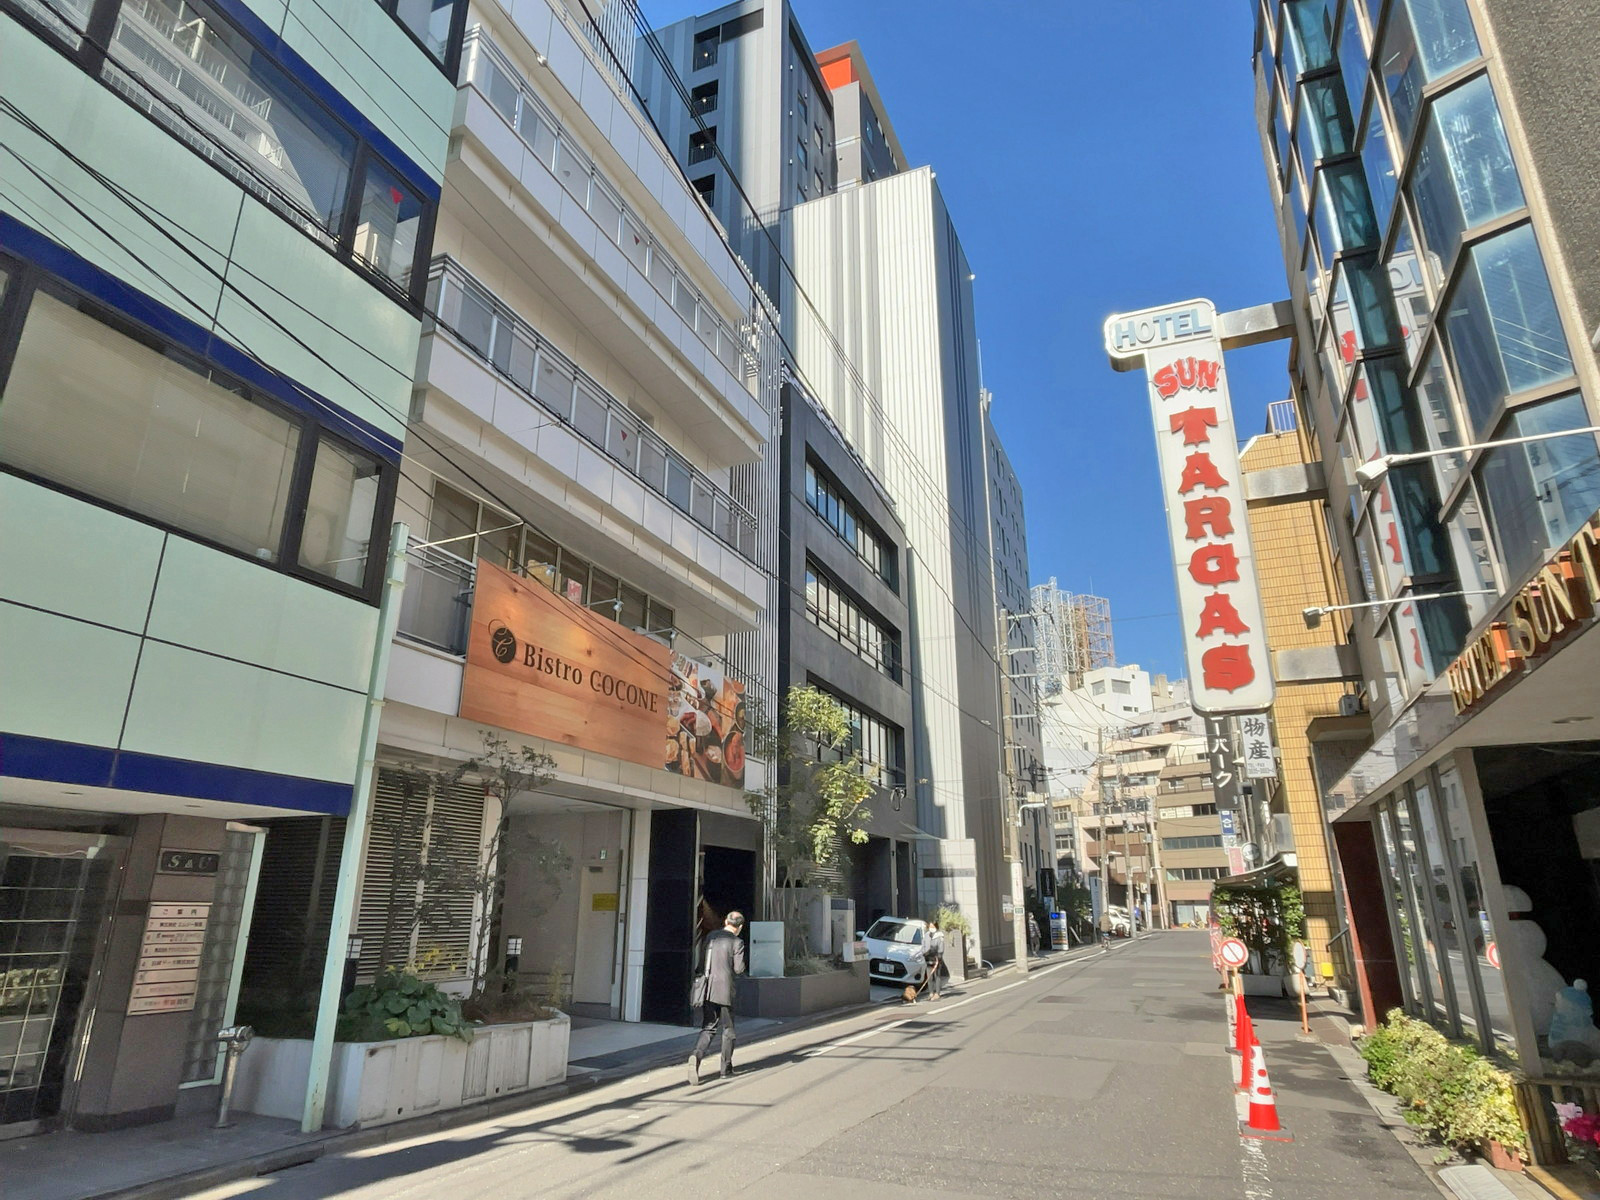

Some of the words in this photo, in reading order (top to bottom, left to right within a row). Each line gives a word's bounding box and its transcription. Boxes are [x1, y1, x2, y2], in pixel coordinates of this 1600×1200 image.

[1114, 309, 1212, 349] HOTEL
[1153, 356, 1221, 400] SUN
[1169, 405, 1256, 694] TARGAS
[1511, 556, 1576, 658] SUN
[523, 643, 583, 686] Bistro
[590, 669, 659, 714] COCONE
[1210, 717, 1233, 788] ーパーク
[1243, 717, 1271, 761] 物産
